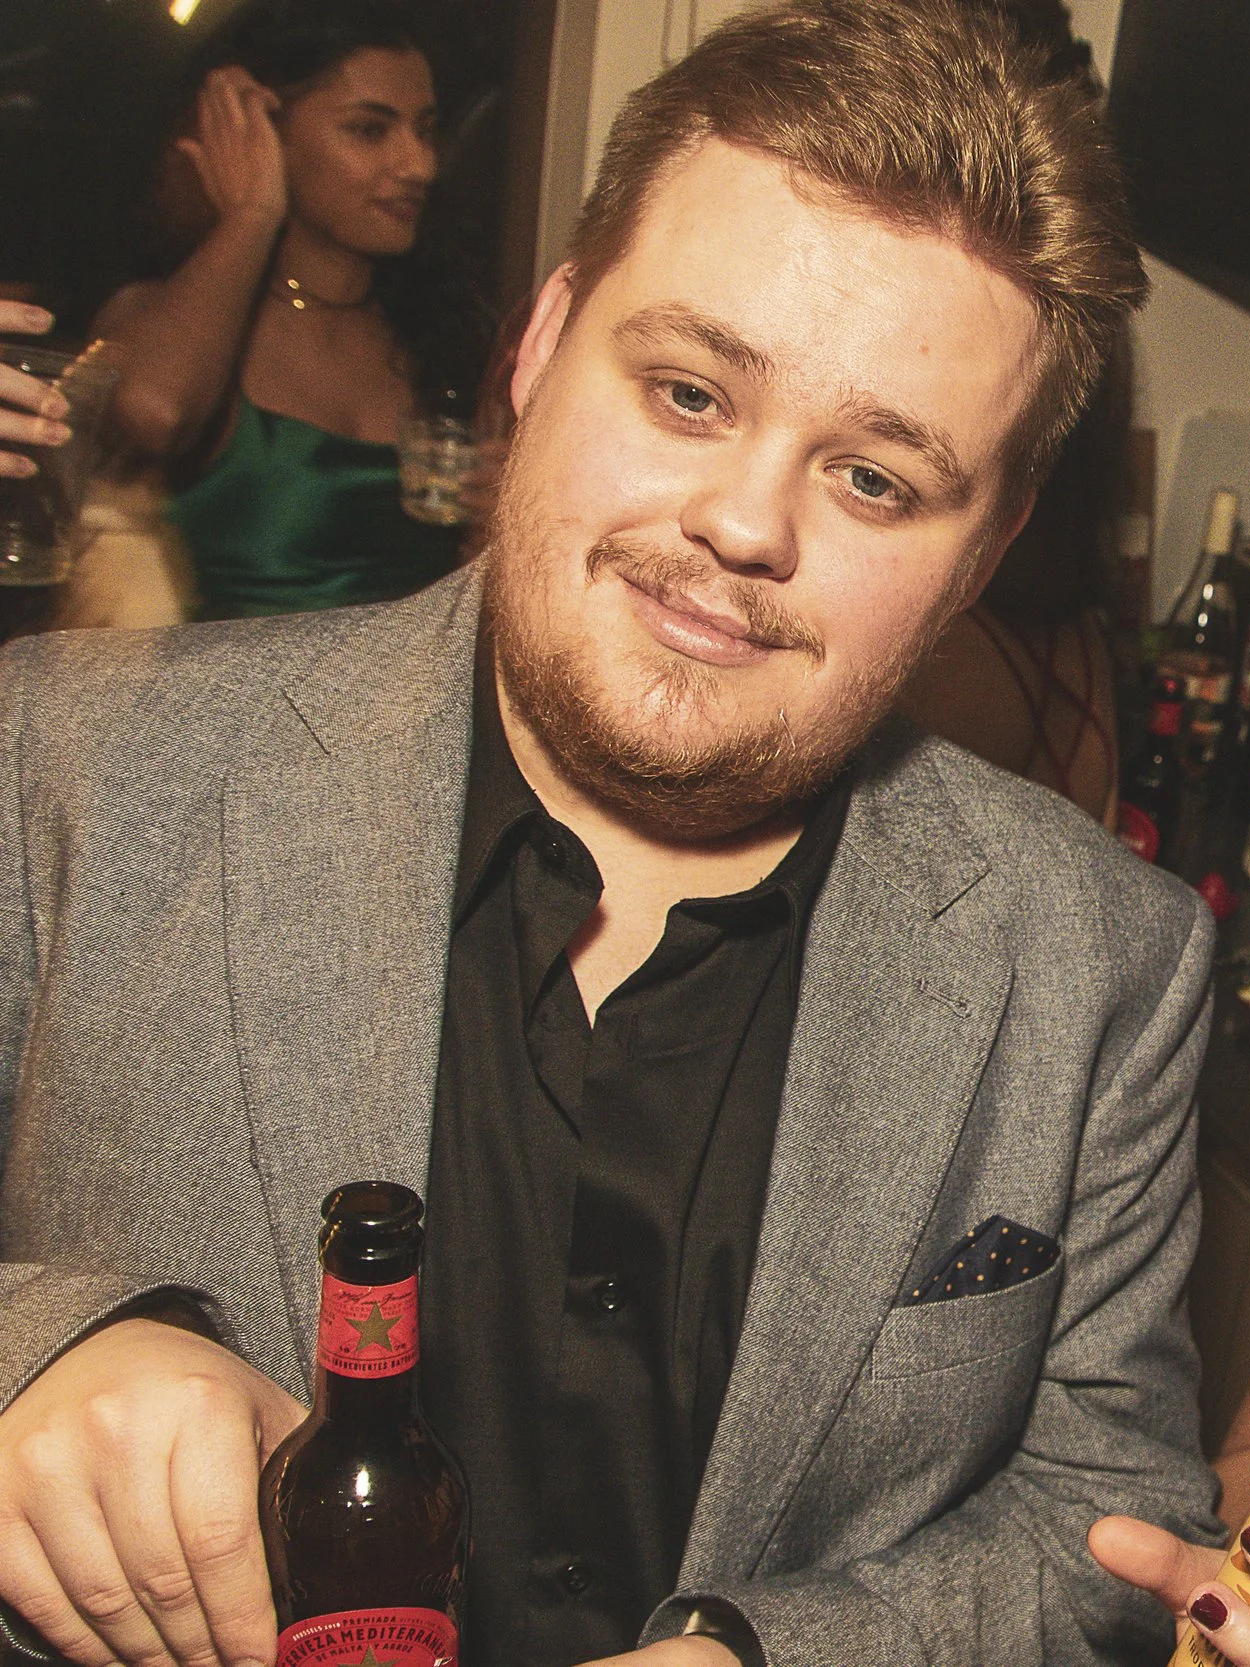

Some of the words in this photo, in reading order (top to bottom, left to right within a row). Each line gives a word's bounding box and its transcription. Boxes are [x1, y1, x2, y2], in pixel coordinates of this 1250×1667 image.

[292, 1625, 323, 1641] BRUSSELS
[342, 1615, 397, 1627] PREMIADA
[329, 1644, 364, 1657] MALTA
